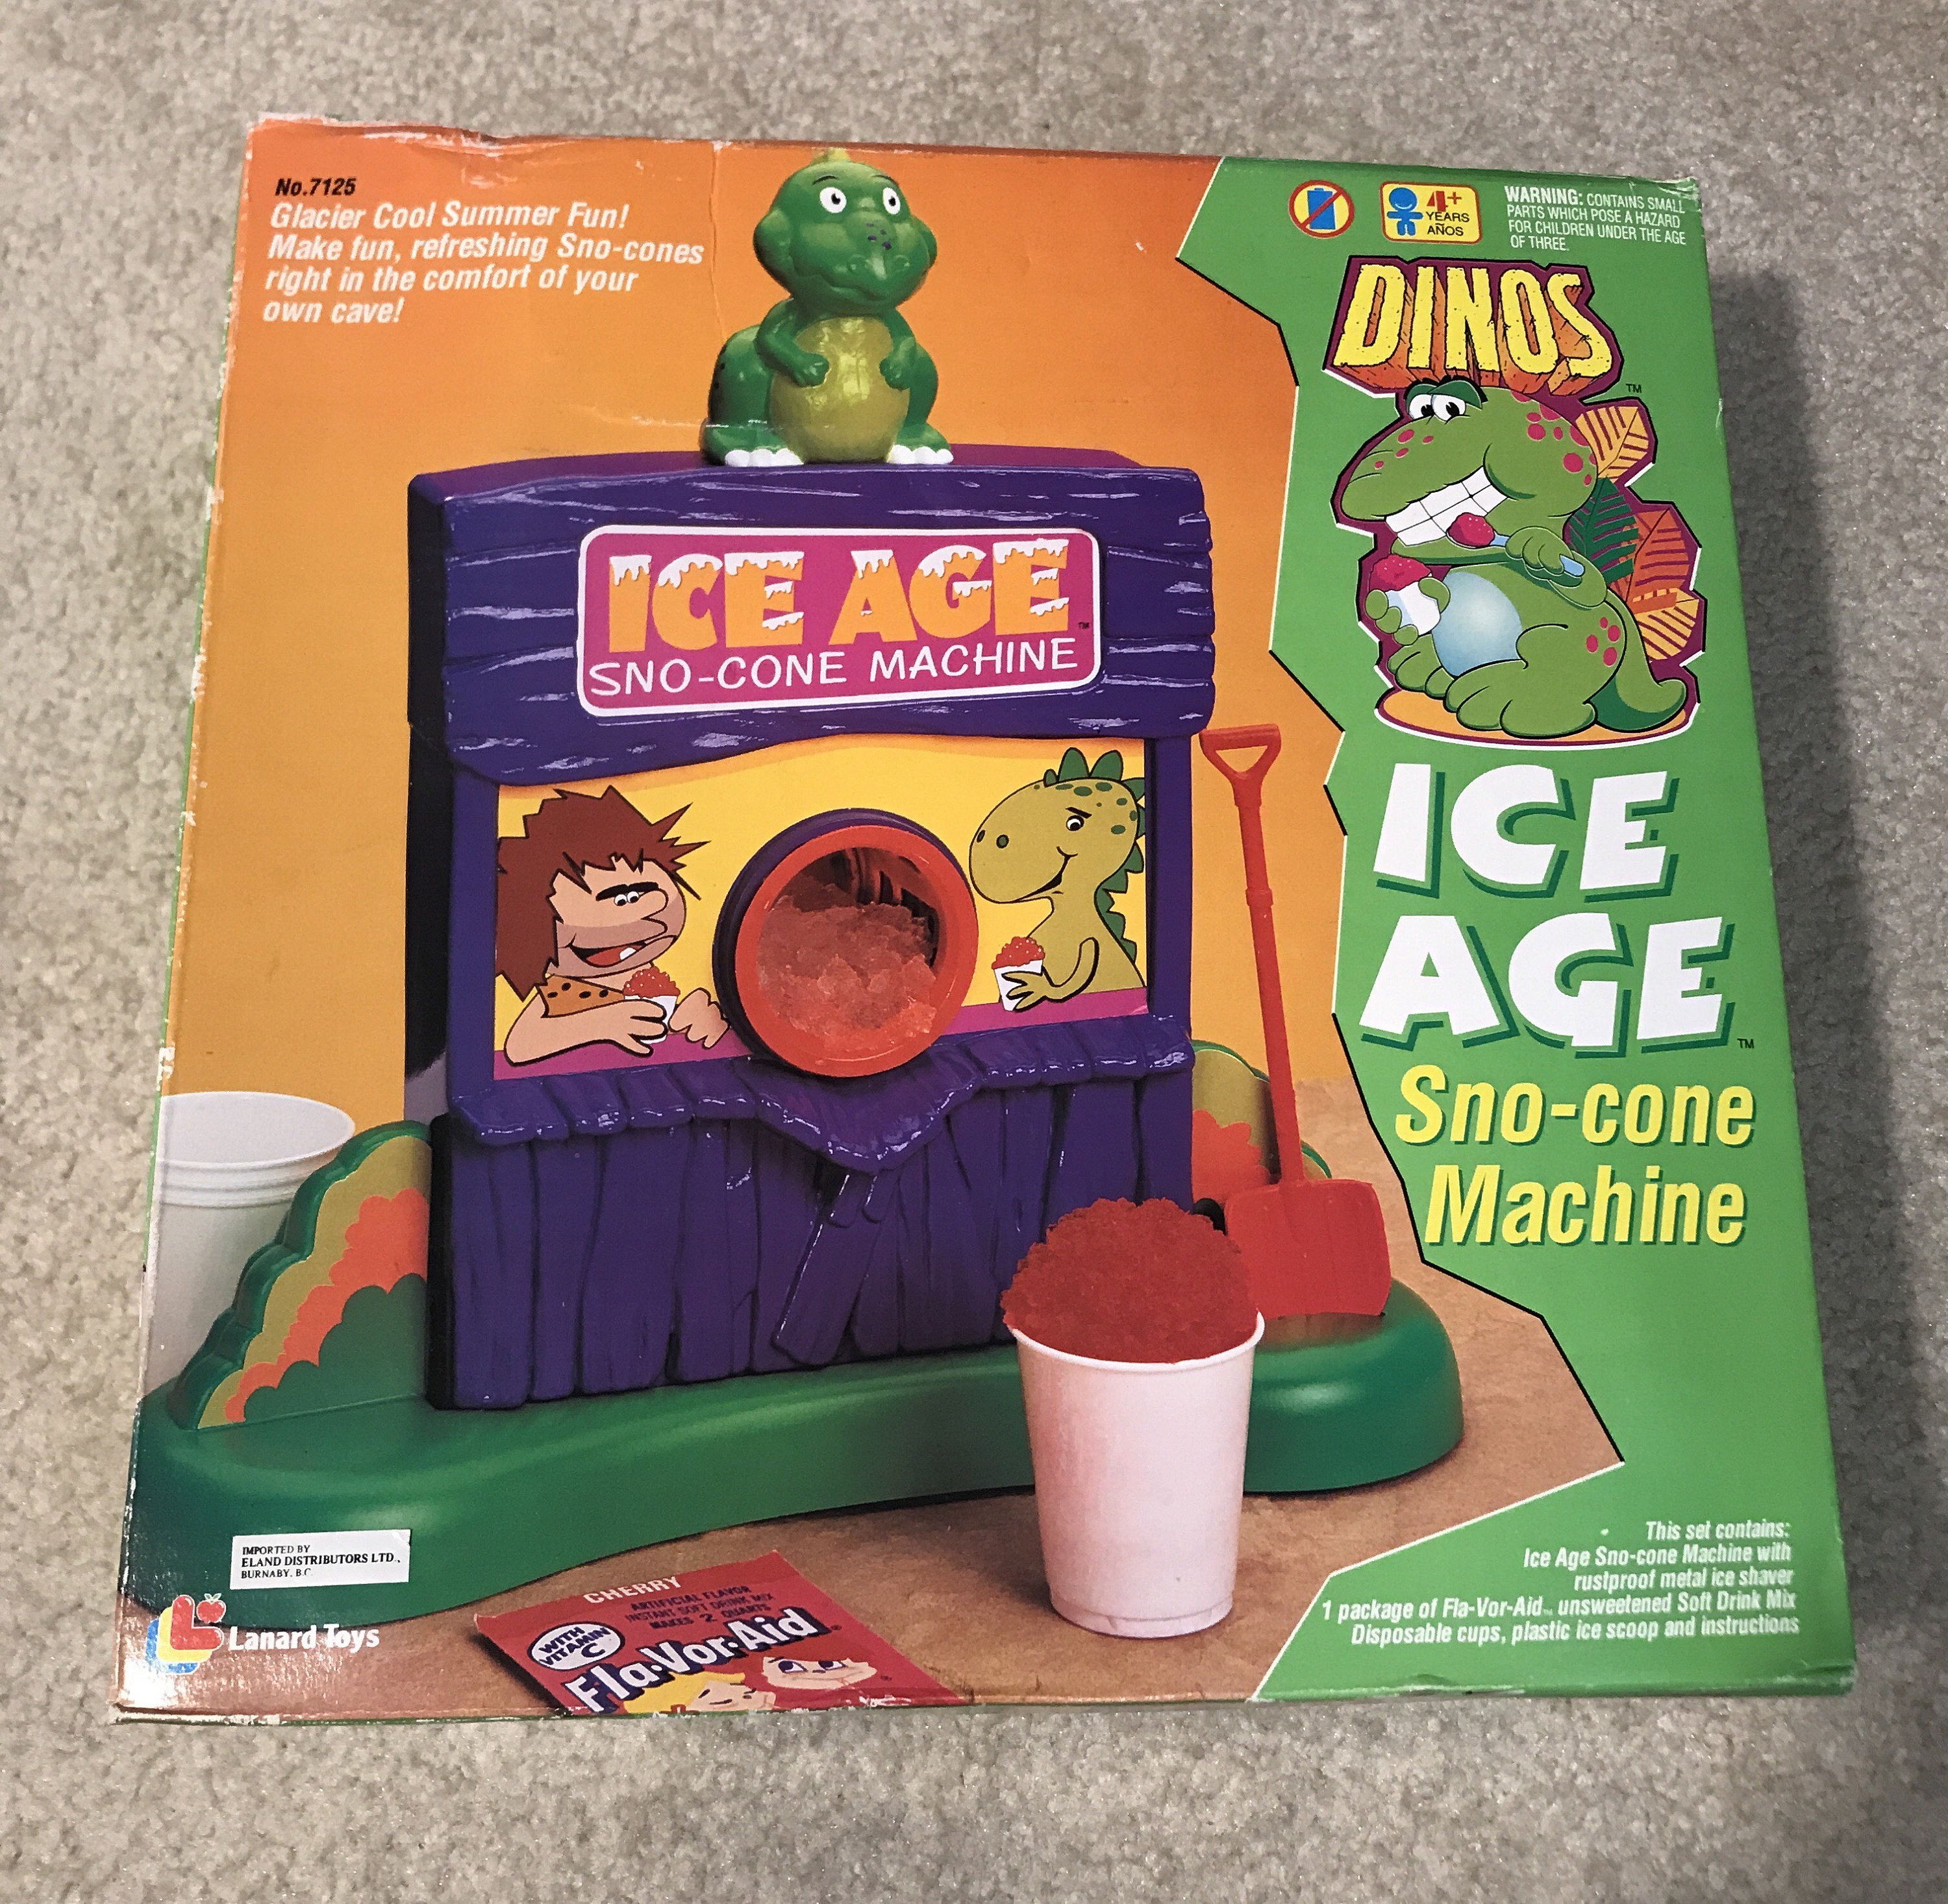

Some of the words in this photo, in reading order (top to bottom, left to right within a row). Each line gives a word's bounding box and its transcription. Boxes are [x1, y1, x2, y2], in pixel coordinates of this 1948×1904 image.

[275, 178, 356, 196] No.7125
[1427, 190, 1462, 212] 4+
[1505, 186, 1584, 206] WARNING:
[1586, 193, 1645, 209] CONTAINS
[1647, 197, 1686, 214] SMALL
[270, 201, 366, 229] Glacier
[373, 201, 437, 229] Cool
[442, 200, 560, 227] Summer
[567, 201, 629, 229] Fun!
[1425, 211, 1470, 223] YEARS
[1506, 204, 1545, 219] PARTS
[1547, 206, 1588, 221] WHICH
[1591, 208, 1621, 223] POSE
[1625, 210, 1633, 224] A
[1635, 211, 1680, 228] HAZARD
[1427, 223, 1464, 236] AÑOS
[1508, 219, 1532, 234] FOR
[1536, 221, 1593, 237] CHILDREN
[1597, 225, 1637, 240] UNDER
[1639, 227, 1662, 243] THE
[1664, 230, 1687, 245] AGE
[1510, 234, 1525, 249] OF
[1528, 235, 1570, 252] THREE.
[268, 234, 343, 260] Make
[350, 234, 401, 264] fun,
[411, 232, 549, 263] refreshing
[557, 232, 705, 265] Sno-cones
[265, 264, 332, 297] right
[338, 266, 364, 292] in
[372, 266, 416, 291] the
[423, 263, 531, 291] comfort
[538, 264, 570, 290] of
[573, 269, 640, 295] your
[262, 300, 323, 323] own
[331, 296, 405, 324] cave!
[1334, 264, 1616, 389] DINOS
[608, 550, 805, 653] ICE
[829, 538, 1069, 645] AGE
[590, 650, 847, 696] SNO-CONE
[869, 637, 1078, 682] MACHINE
[1373, 762, 1671, 896] ICE
[1359, 912, 1727, 1052] AGE
[1394, 1064, 1754, 1146] Sno-cone
[1424, 1163, 1746, 1245] Machine
[1646, 1520, 1681, 1540] This
[1685, 1520, 1711, 1540] set
[1716, 1518, 1791, 1539] contains:
[242, 1545, 294, 1555] IMPORTED
[297, 1545, 310, 1553] BY
[242, 1556, 282, 1567] ELAND
[284, 1553, 368, 1566] DISTRIBUTORS
[1523, 1548, 1551, 1568] Ice
[1555, 1546, 1590, 1572] Age
[1595, 1546, 1677, 1566] Sno-cone
[1682, 1542, 1753, 1564] Machine
[1757, 1541, 1792, 1562] with
[583, 1576, 681, 1604] CHERRY
[1574, 1569, 1656, 1594] rustproof
[1660, 1567, 1707, 1588] metal
[1712, 1566, 1735, 1587] ice
[1739, 1565, 1794, 1586] shaver
[630, 1594, 702, 1611] ARTIFICIAL
[1322, 1599, 1332, 1620] 1
[1338, 1598, 1414, 1624] package
[1419, 1598, 1438, 1618] of
[1442, 1595, 1543, 1618] Fla-Vor-Aid
[1558, 1592, 1672, 1616] unsweetened
[1677, 1590, 1712, 1613] Soft
[1717, 1589, 1761, 1611] Drink
[1766, 1588, 1797, 1609] Mix
[699, 1613, 718, 1622] 2
[1351, 1623, 1452, 1648] Disposable
[1457, 1624, 1506, 1648] cups,
[1512, 1620, 1570, 1646] plastic
[1576, 1619, 1601, 1640] ice
[1606, 1620, 1658, 1642] scoop
[1664, 1616, 1696, 1637] and
[1701, 1614, 1800, 1637] instructions
[228, 1624, 318, 1651] Lanard
[324, 1623, 381, 1653] Toys
[538, 1626, 586, 1654] WITH
[538, 1626, 611, 1666] VITAMIN
[581, 1642, 606, 1658] C
